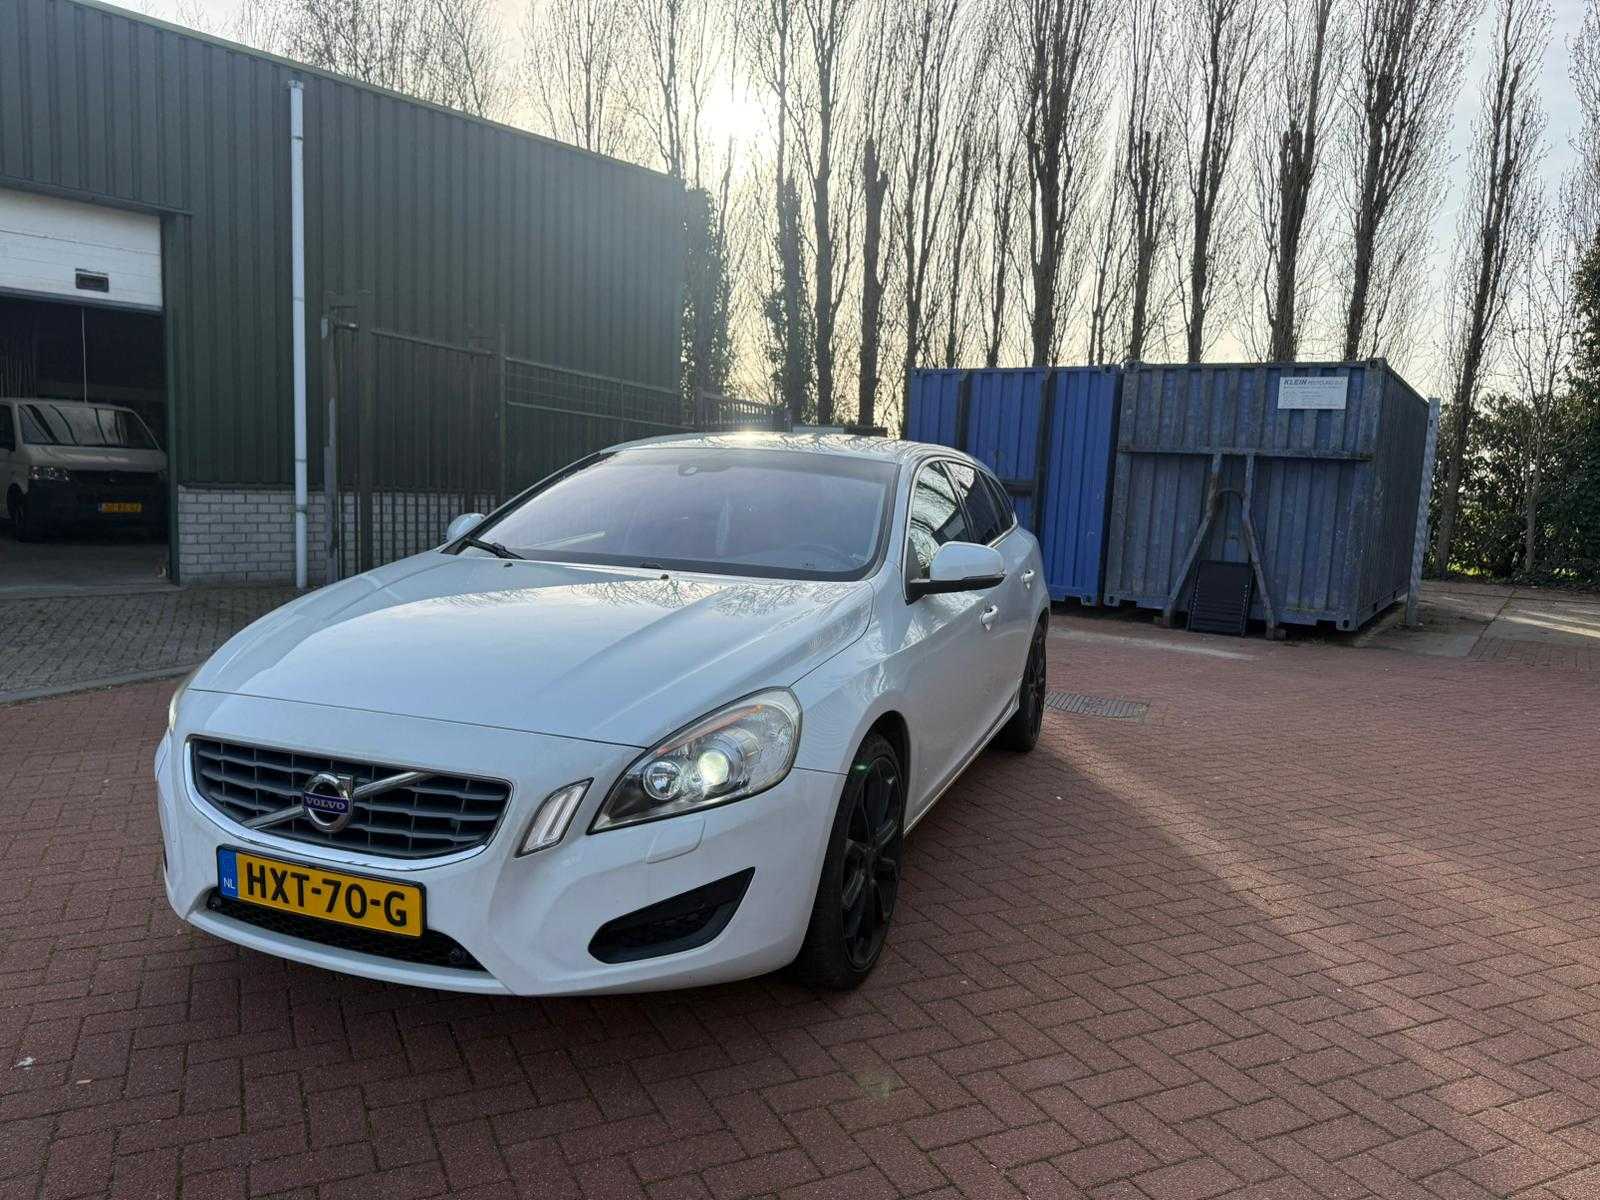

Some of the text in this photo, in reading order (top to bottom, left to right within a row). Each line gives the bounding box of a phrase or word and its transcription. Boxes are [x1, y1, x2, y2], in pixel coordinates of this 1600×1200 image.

[304, 796, 346, 810] VOLVO
[223, 877, 236, 890] NL
[246, 862, 407, 927] HXT-70-G
